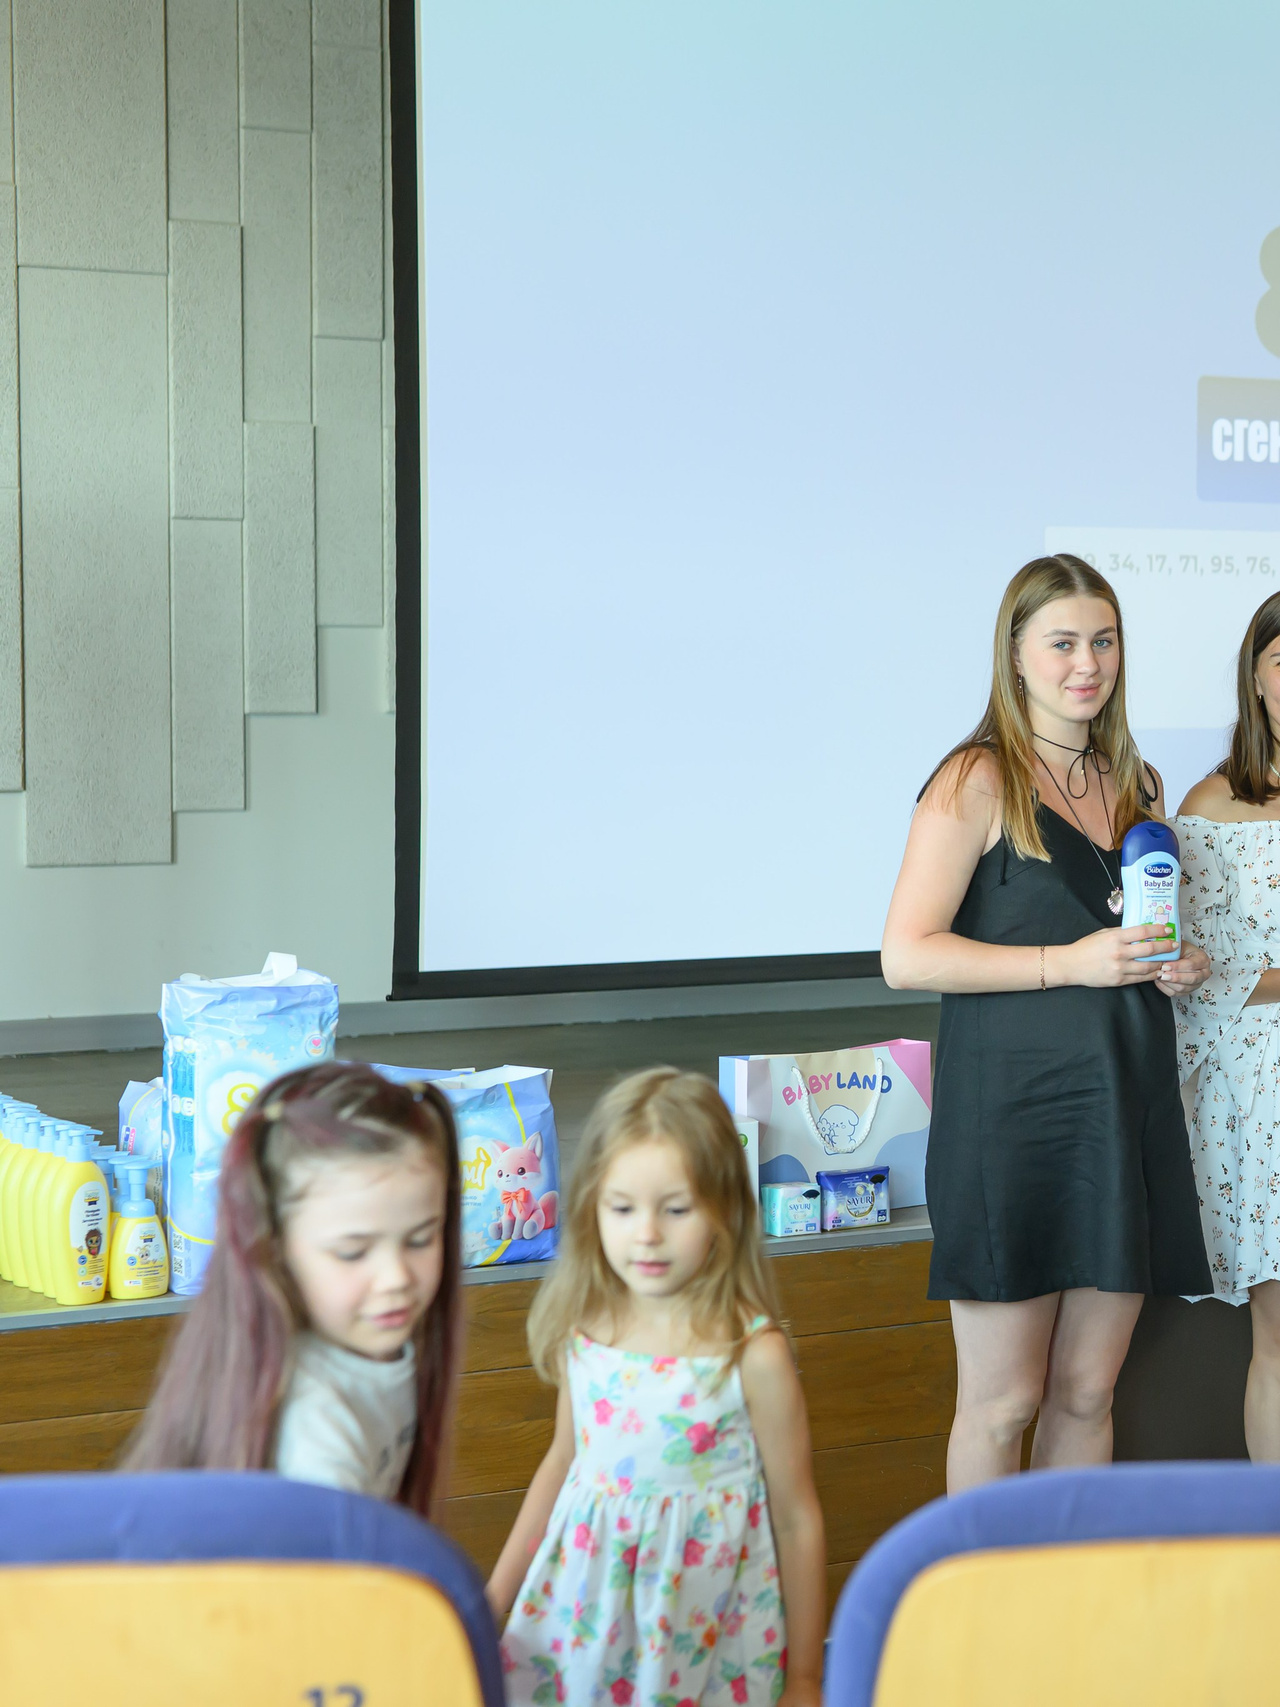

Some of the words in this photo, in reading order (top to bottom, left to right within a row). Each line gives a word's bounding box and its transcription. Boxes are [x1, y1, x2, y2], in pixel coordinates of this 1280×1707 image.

[1108, 554, 1140, 576] 34,
[1147, 554, 1172, 577] 17,
[1179, 555, 1204, 577] 71,
[1210, 555, 1240, 577] 95,
[1246, 556, 1276, 578] 76,
[1144, 880, 1161, 888] Baby
[846, 1195, 873, 1206] SAYURI
[788, 1203, 811, 1211] SAYURI
